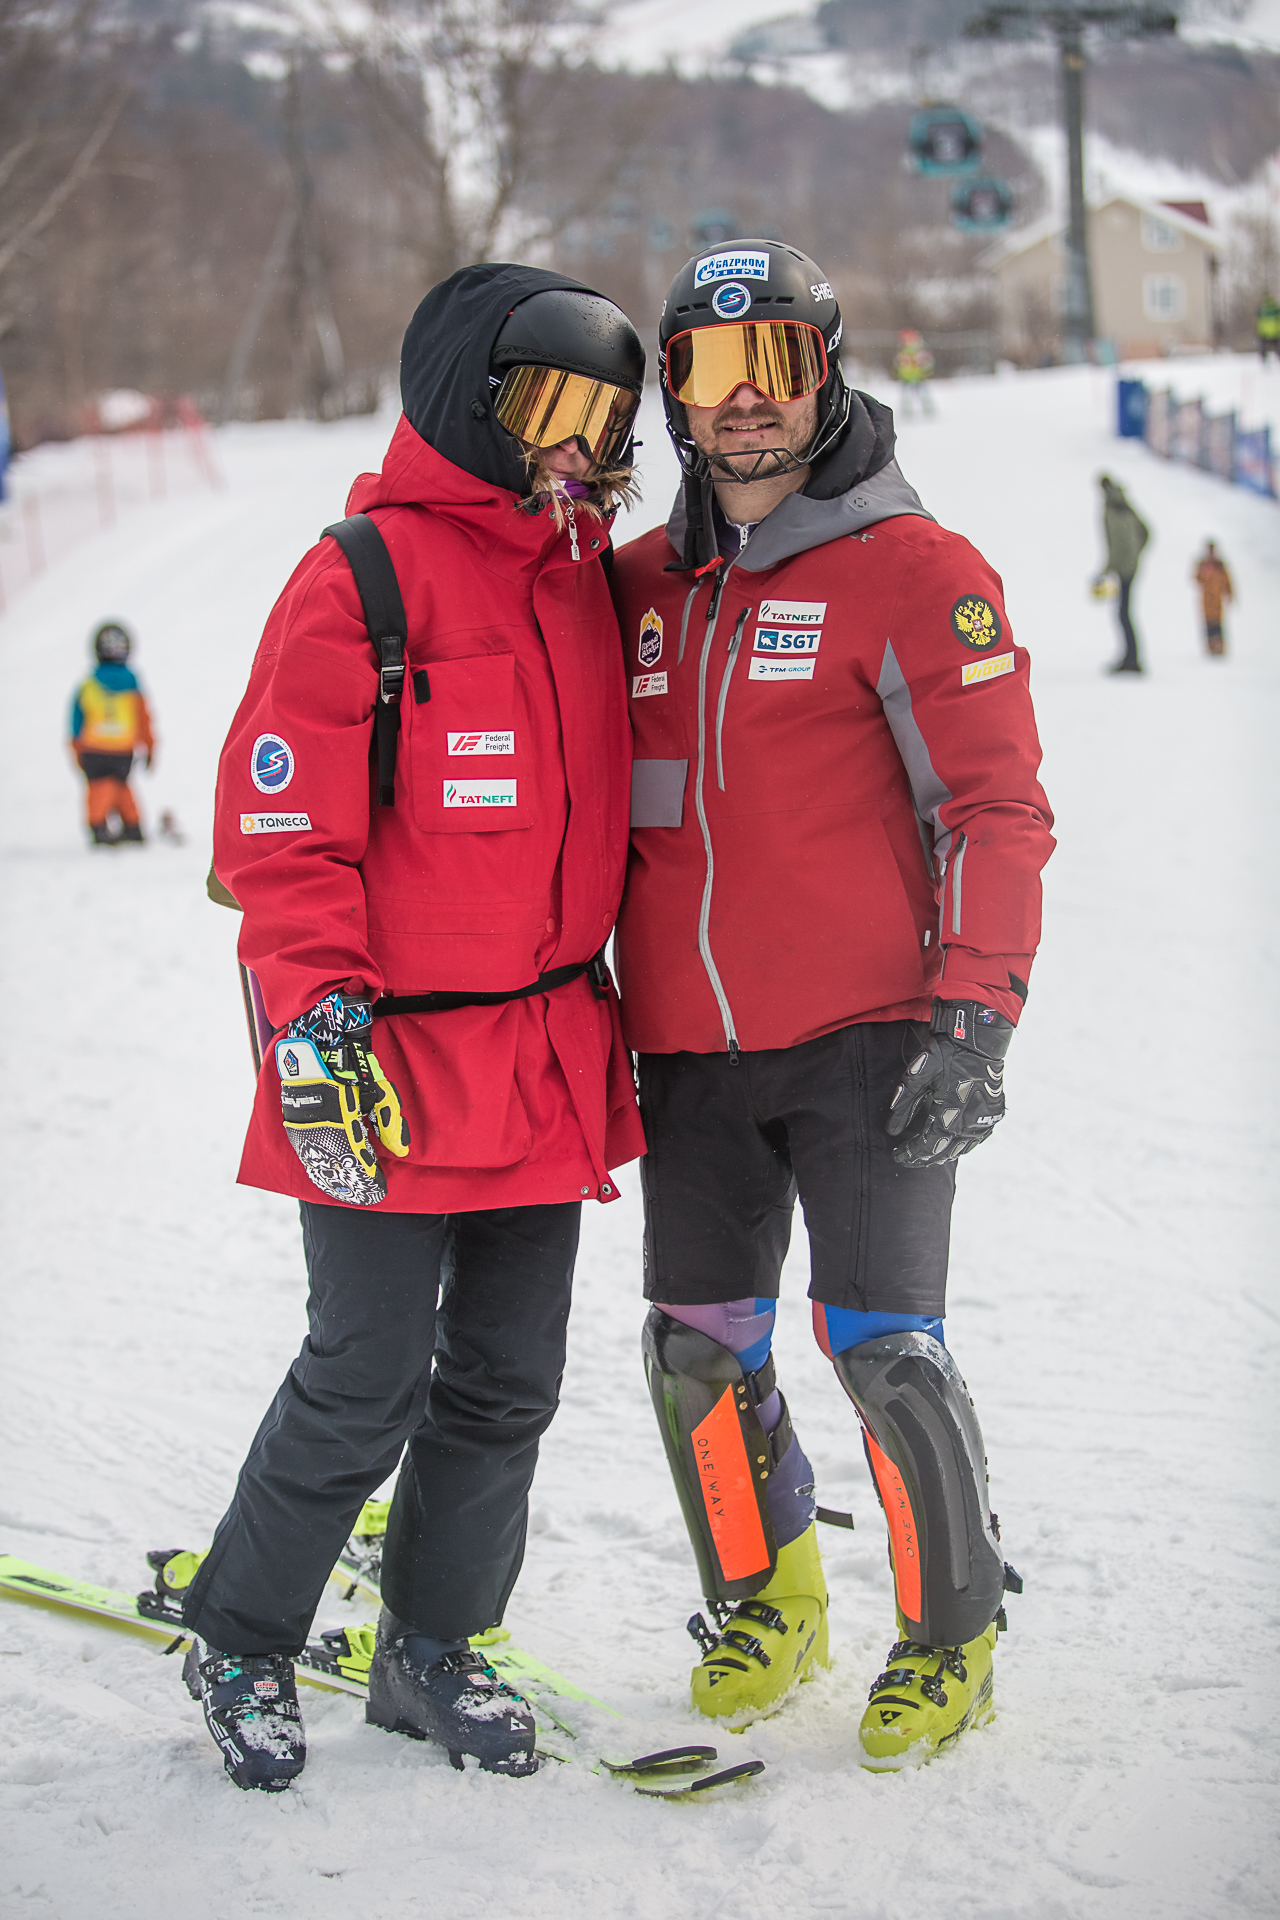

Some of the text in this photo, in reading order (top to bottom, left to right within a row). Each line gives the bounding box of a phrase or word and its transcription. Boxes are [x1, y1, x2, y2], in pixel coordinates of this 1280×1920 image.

[715, 258, 765, 269] GAZPROM
[771, 612, 821, 622] TATNEFT
[780, 633, 818, 649] SGT
[964, 659, 1012, 682] Viatti
[651, 684, 665, 692] Freight
[485, 734, 511, 742] Federal
[485, 743, 510, 752] Freight
[458, 795, 514, 804] TATNEFT
[353, 1042, 369, 1073] LEKI
[697, 1438, 726, 1518] ONE/WAY
[892, 1472, 915, 1558] ONE/WAY
